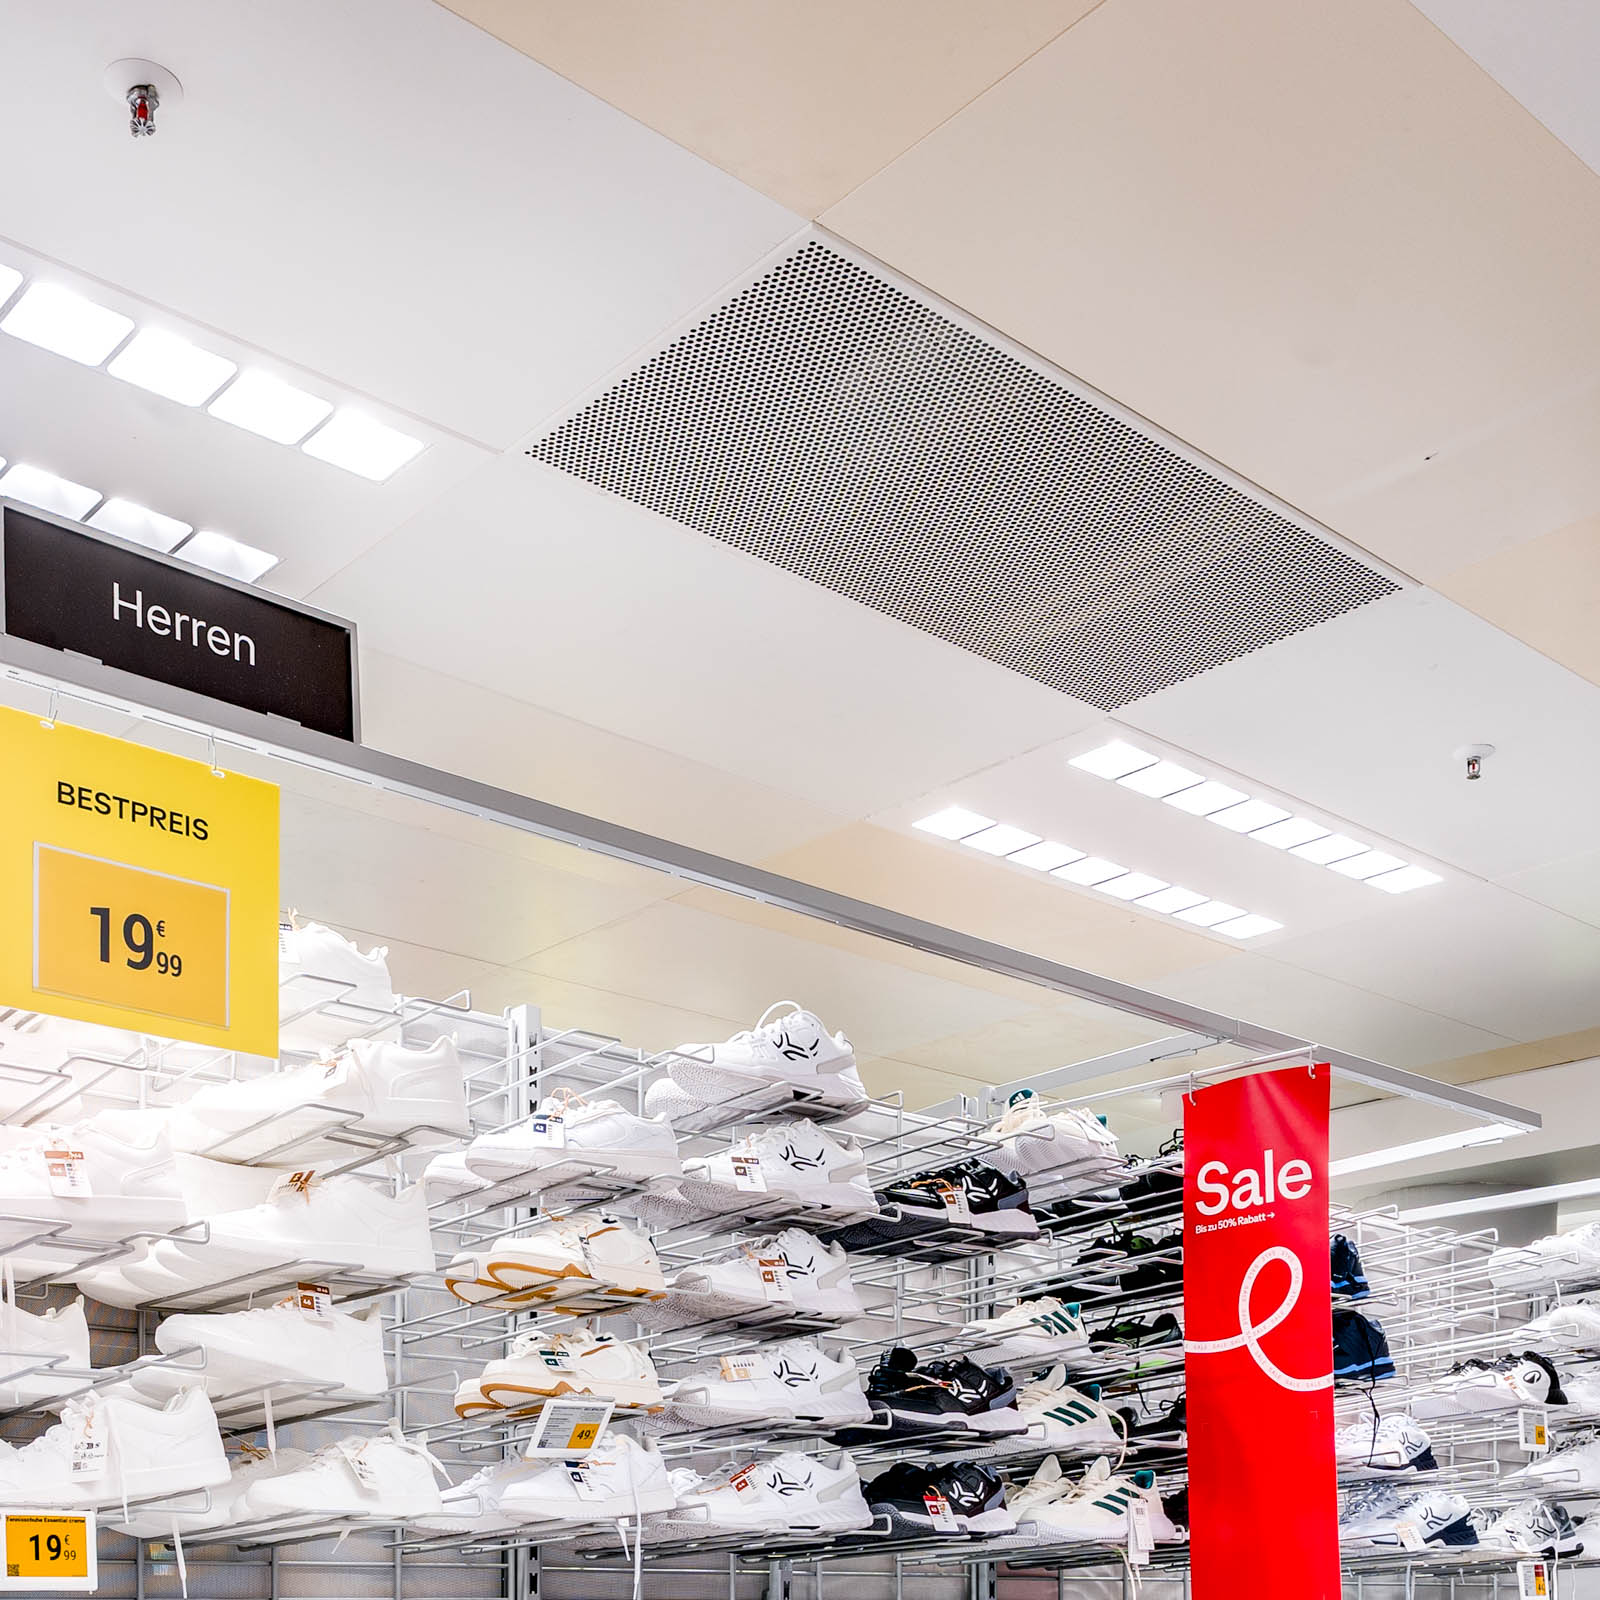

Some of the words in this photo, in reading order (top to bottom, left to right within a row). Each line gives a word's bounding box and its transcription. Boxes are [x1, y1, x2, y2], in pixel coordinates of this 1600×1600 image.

[112, 582, 256, 666] Herren
[56, 780, 209, 841] BESTPREIS
[1195, 1149, 1313, 1216] Sale
[1195, 1224, 1208, 1234] Bis
[1208, 1222, 1217, 1231] zu
[1218, 1217, 1238, 1230] 50%
[1237, 1212, 1266, 1226] Rabatt
